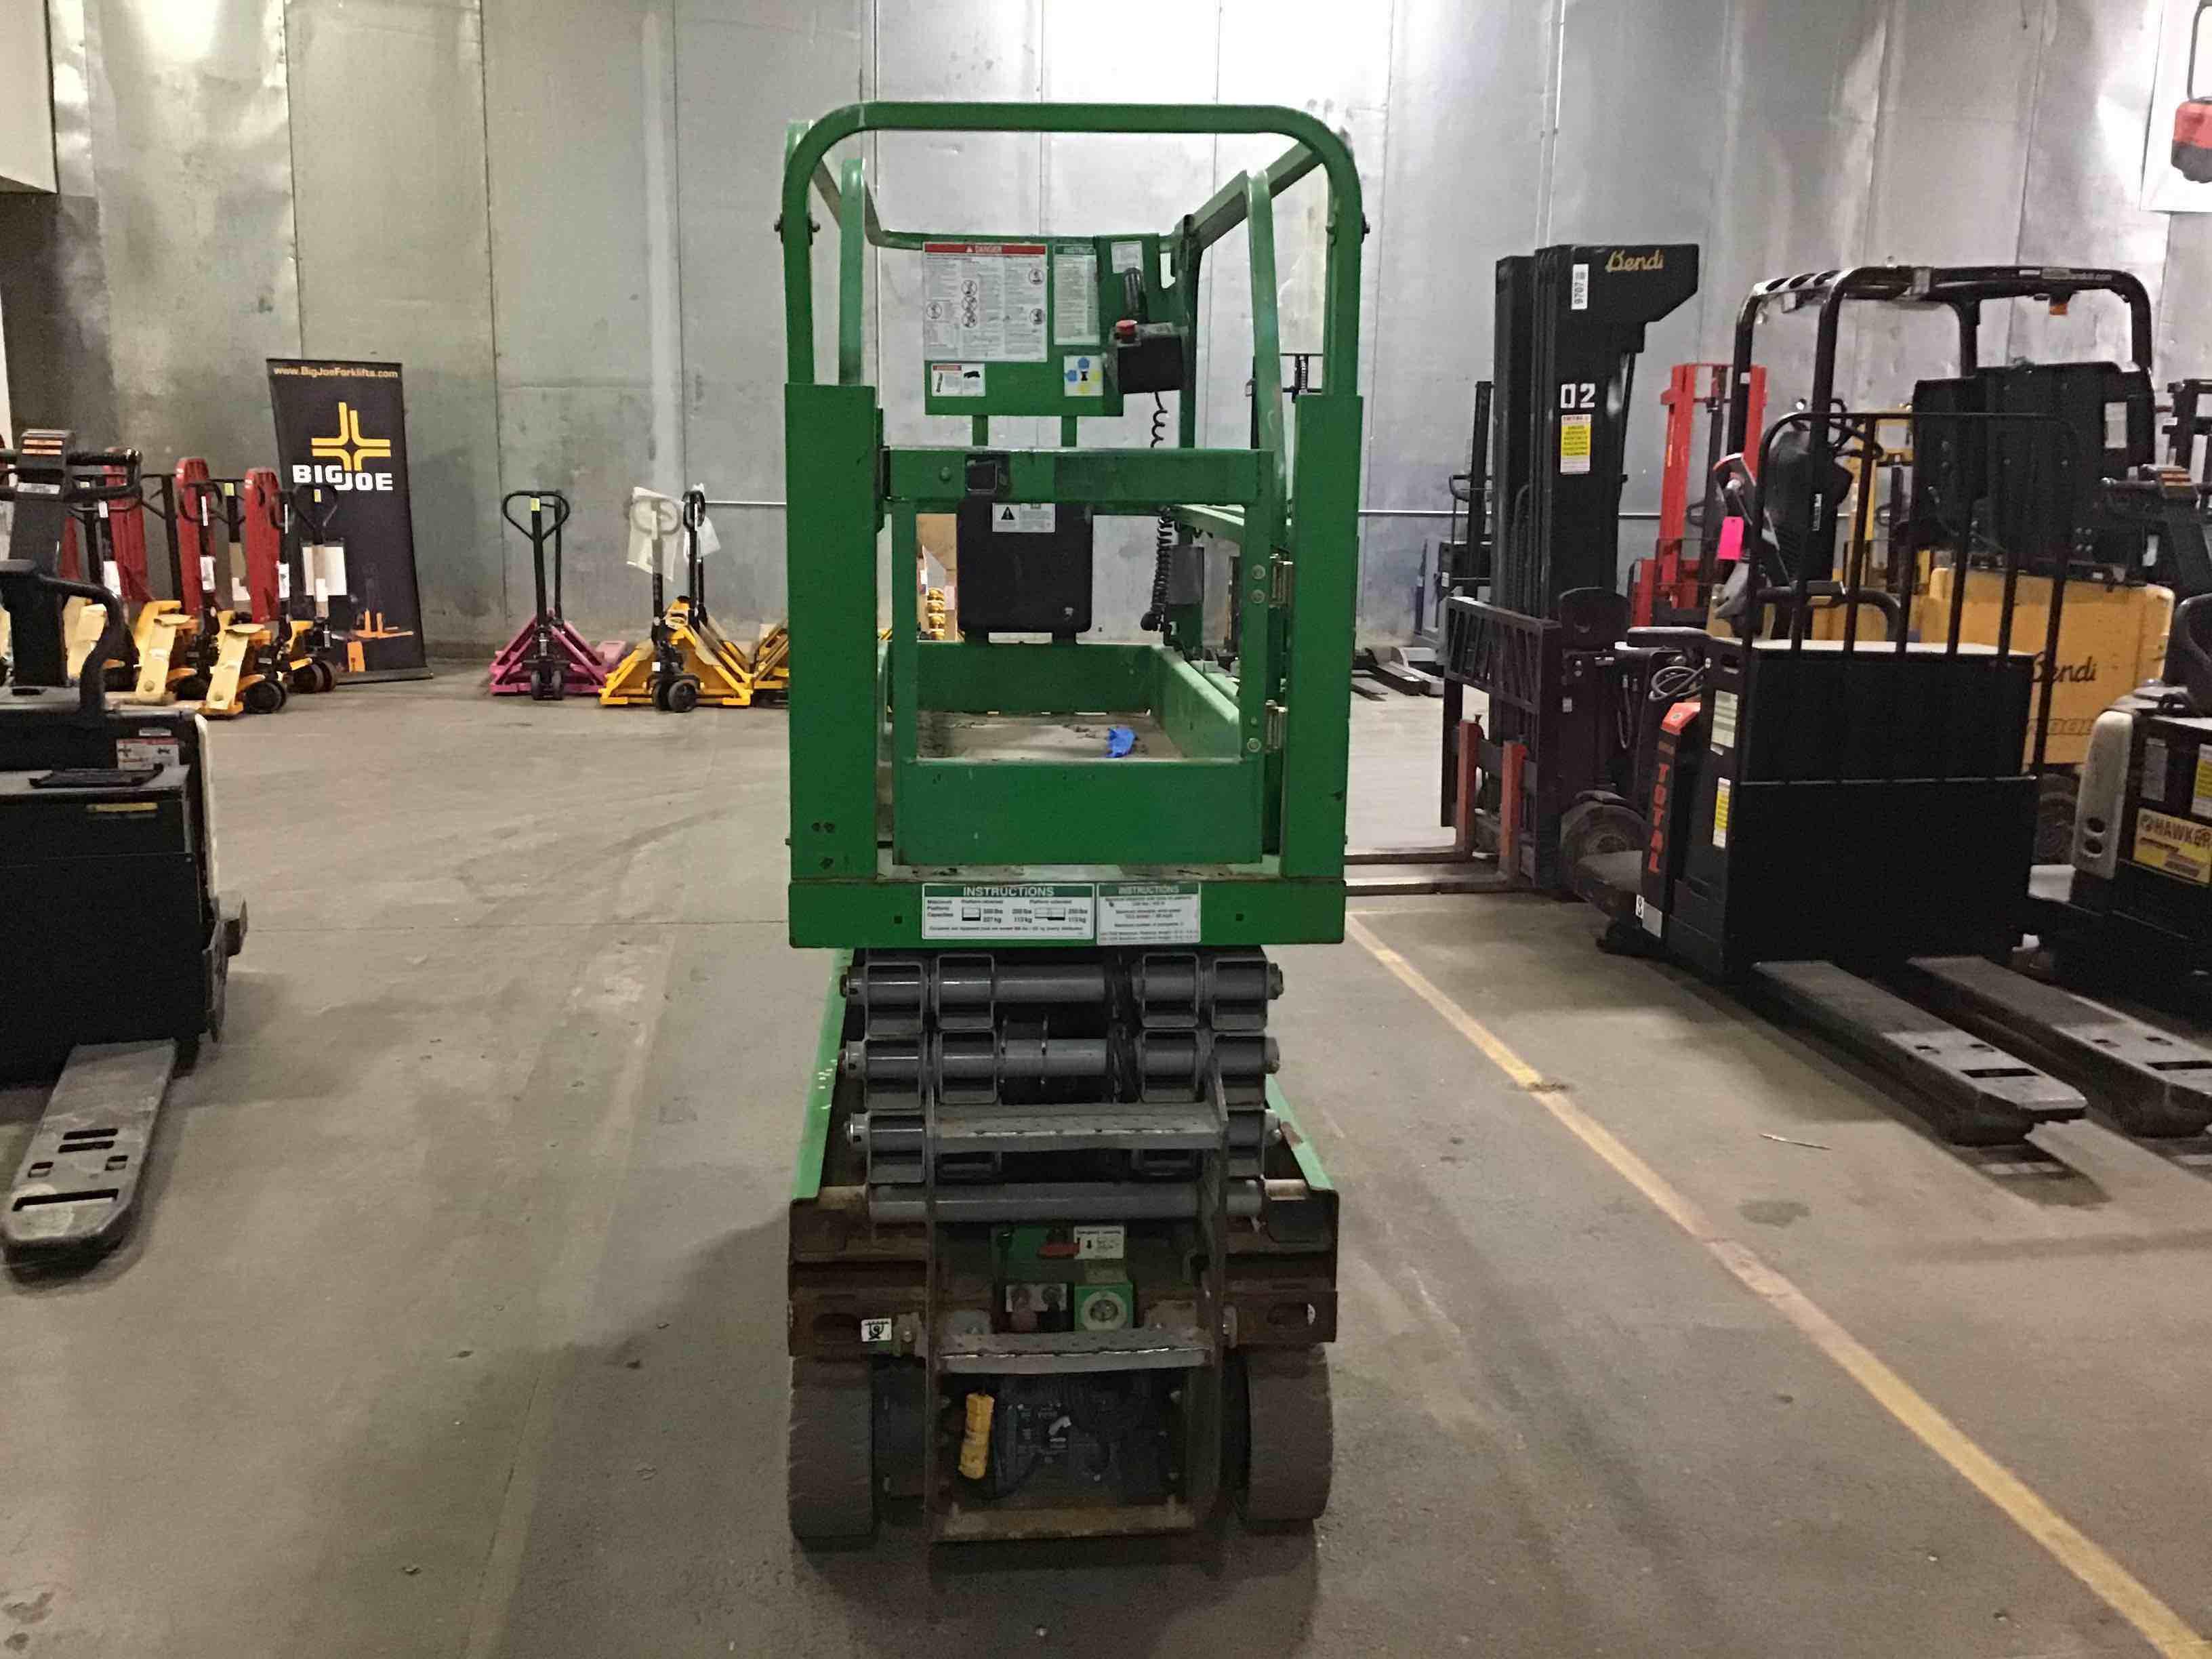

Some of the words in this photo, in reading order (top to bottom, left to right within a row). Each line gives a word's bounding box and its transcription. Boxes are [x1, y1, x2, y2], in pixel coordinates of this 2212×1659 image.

[1605, 249, 1664, 272] Bendi
[1560, 383, 1595, 409] 02
[292, 465, 343, 483] BIG
[334, 473, 393, 491] JOE
[964, 886, 1054, 896] INSTRUCTIONS
